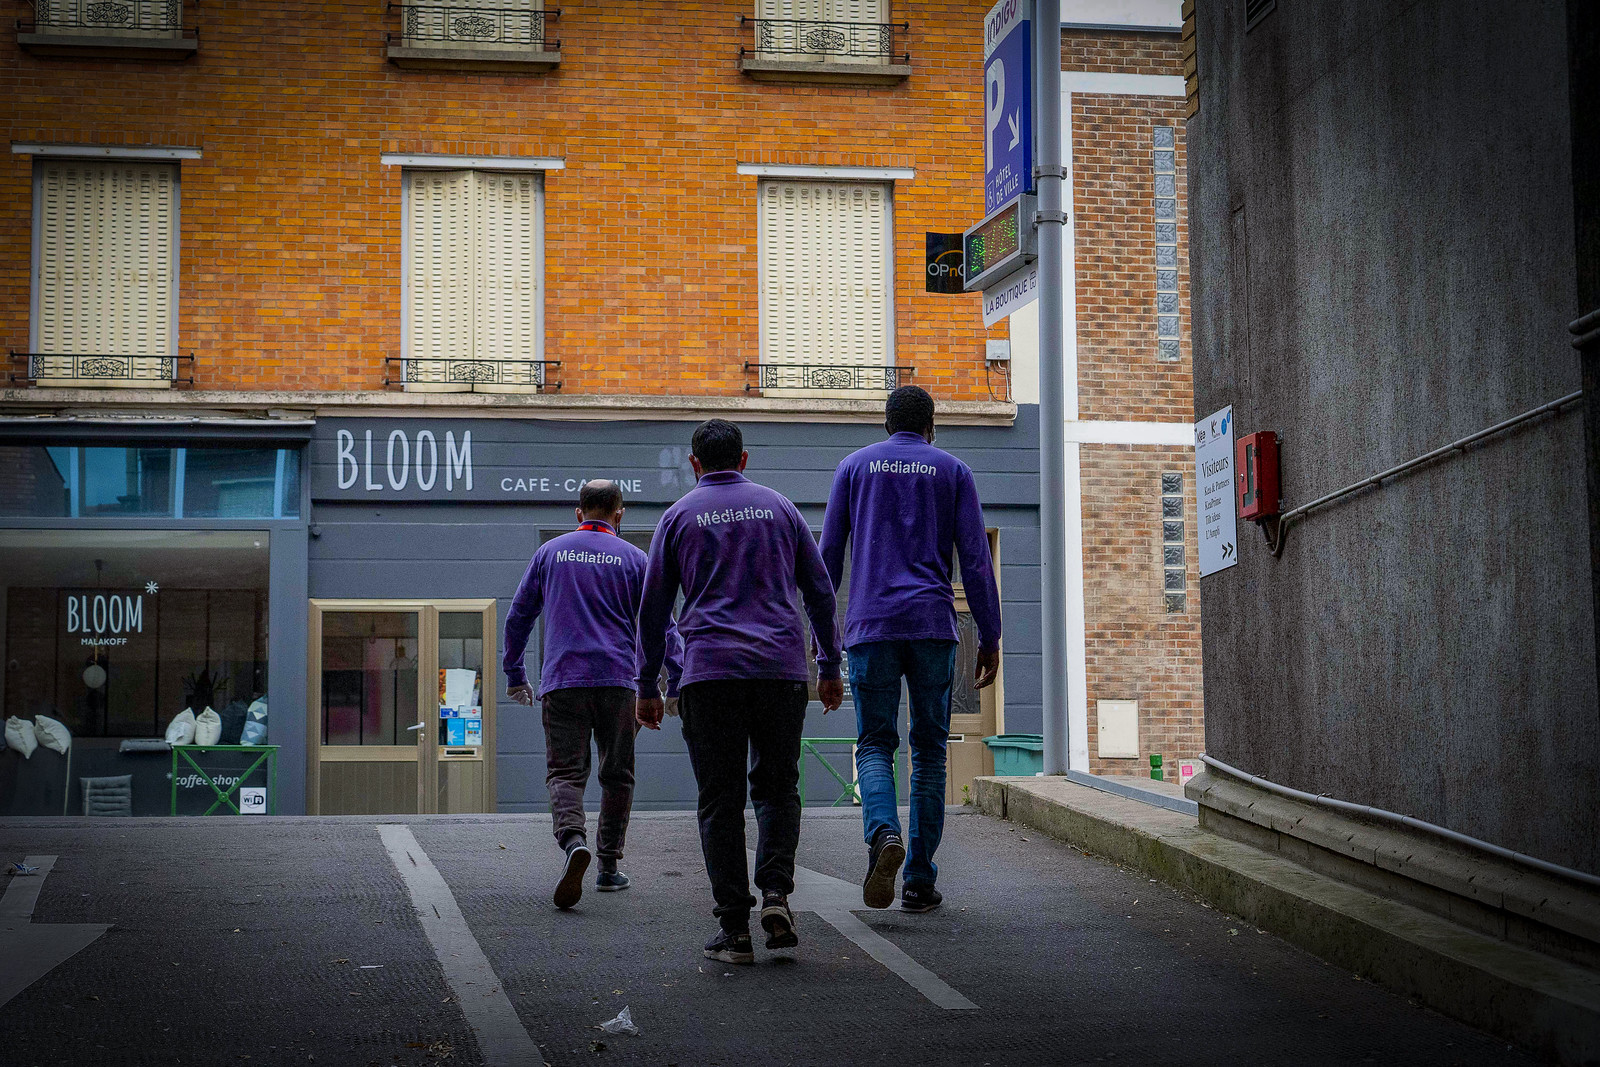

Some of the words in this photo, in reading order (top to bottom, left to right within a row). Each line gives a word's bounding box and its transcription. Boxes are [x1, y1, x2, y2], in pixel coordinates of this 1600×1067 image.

[986, 57, 1005, 174] P
[996, 188, 1003, 205] DE
[1003, 173, 1019, 197] VILLE
[985, 301, 995, 316] LA
[996, 279, 1028, 310] BOUTIQUE
[337, 429, 473, 491] BLOOM
[869, 459, 937, 477] Médiation
[1201, 456, 1229, 479] Visiteurs
[564, 479, 642, 493] CANE
[696, 505, 774, 528] Médiation
[556, 549, 622, 566] Médiation
[67, 594, 143, 634] BLOOM
[81, 638, 128, 646] MALAKOFF
[212, 774, 240, 788] shop
[905, 890, 918, 898] FILA
